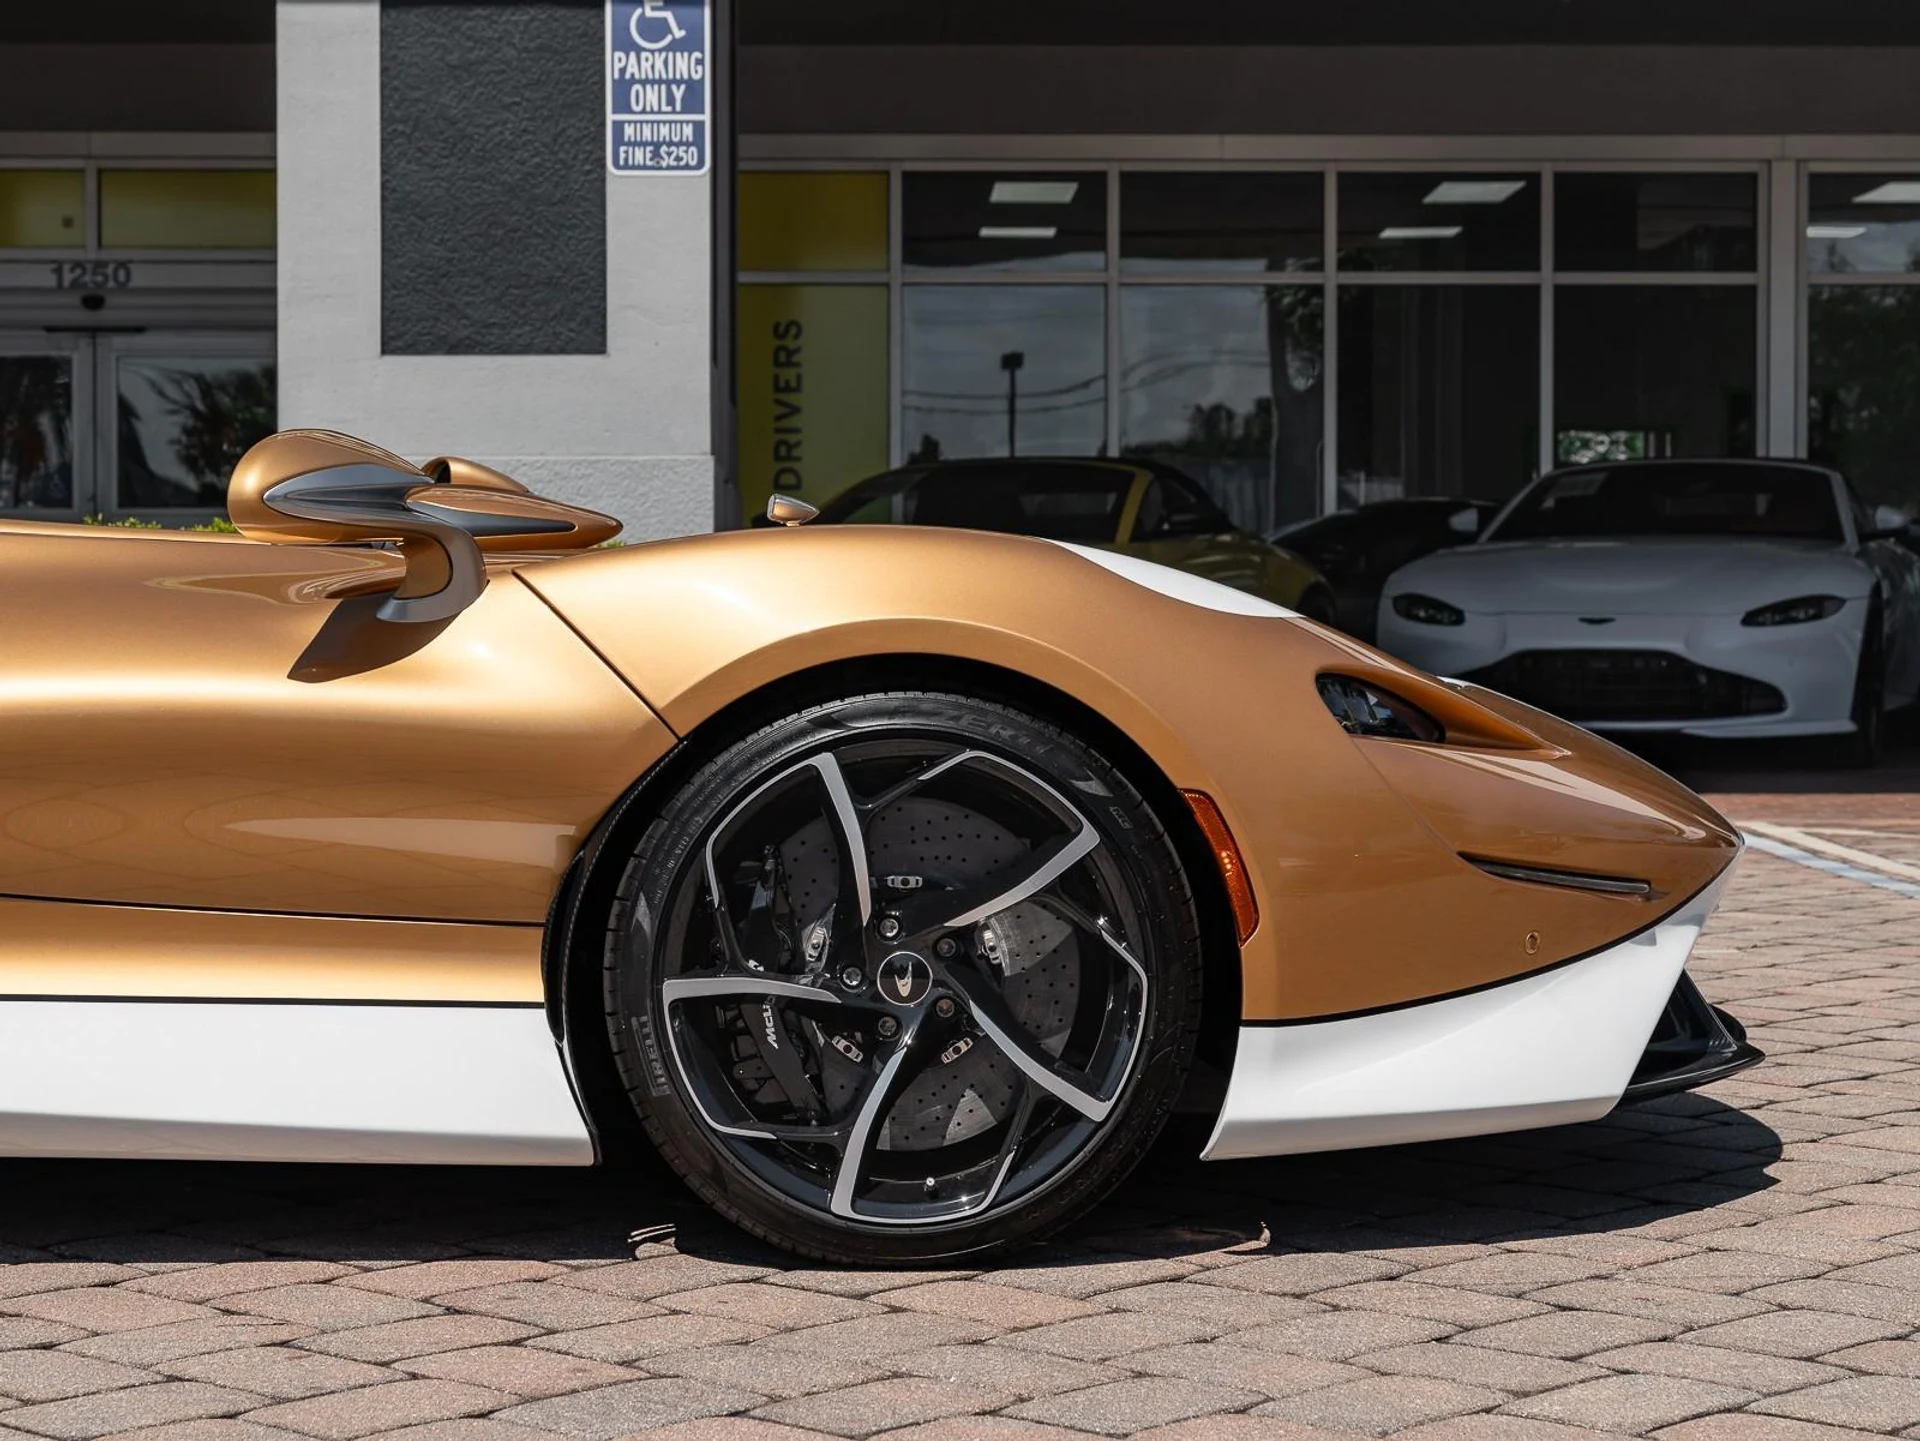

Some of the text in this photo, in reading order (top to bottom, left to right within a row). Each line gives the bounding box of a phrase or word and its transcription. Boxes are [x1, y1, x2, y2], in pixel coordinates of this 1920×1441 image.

[613, 51, 703, 80] PARKING
[630, 83, 686, 112] ONLY
[623, 122, 694, 142] MINIMUM
[619, 144, 698, 168] FINE $250
[50, 261, 132, 289] 1250
[773, 318, 803, 491] DRIVERS
